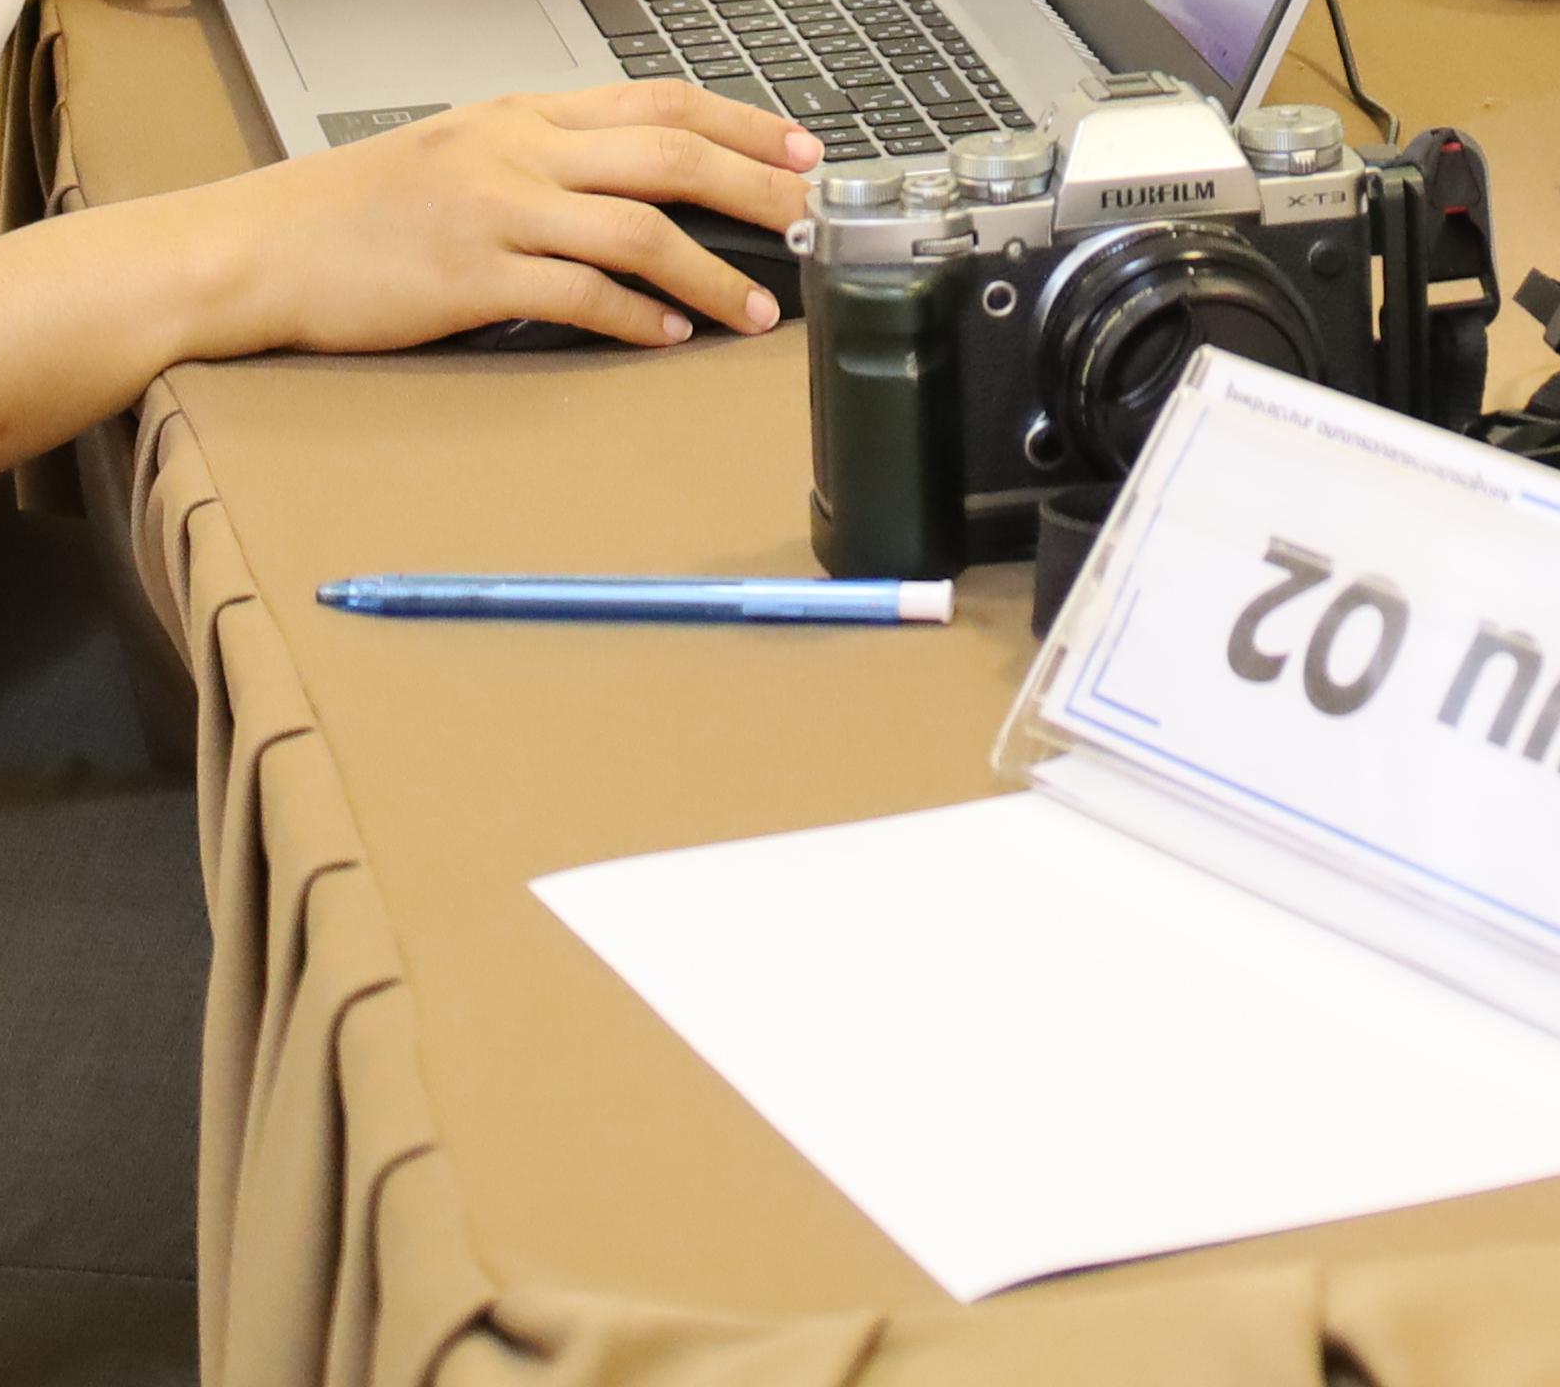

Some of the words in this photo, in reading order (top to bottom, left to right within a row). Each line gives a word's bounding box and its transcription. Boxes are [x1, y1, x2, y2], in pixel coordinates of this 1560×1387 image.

[1101, 181, 1215, 209] FUJIFILM
[1288, 190, 1347, 208] X-T3
[1225, 535, 1412, 717] 02
